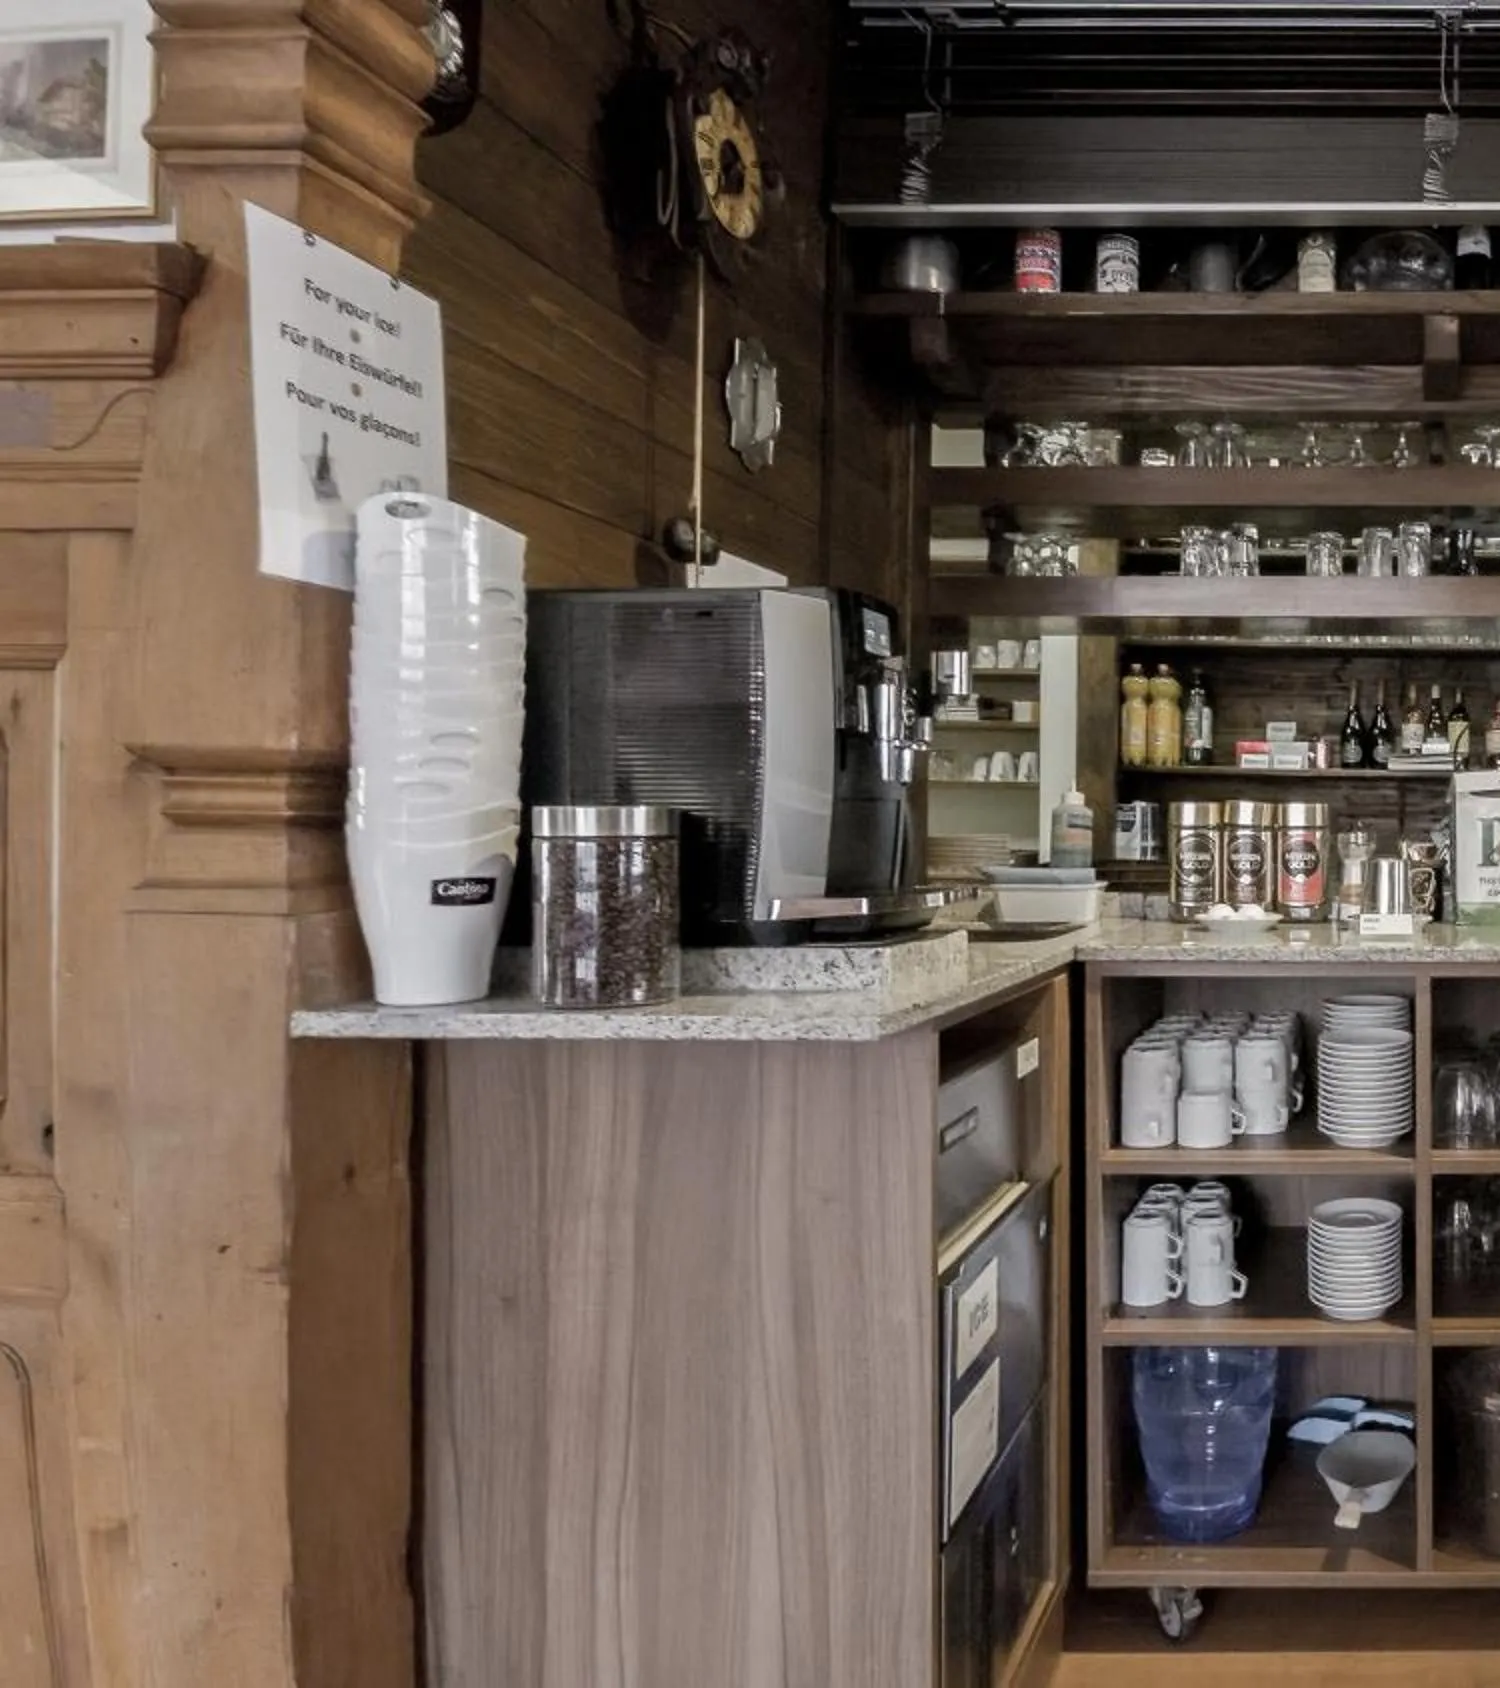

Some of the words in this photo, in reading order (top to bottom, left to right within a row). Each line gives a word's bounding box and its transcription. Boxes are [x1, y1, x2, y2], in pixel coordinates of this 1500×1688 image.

[304, 278, 332, 305] For
[336, 297, 371, 324] your
[374, 312, 401, 338] ice!
[280, 321, 308, 348] Für
[312, 336, 347, 366] Ihre
[286, 380, 325, 410] Pour
[330, 403, 357, 424] vos
[969, 1293, 989, 1338] ICE
